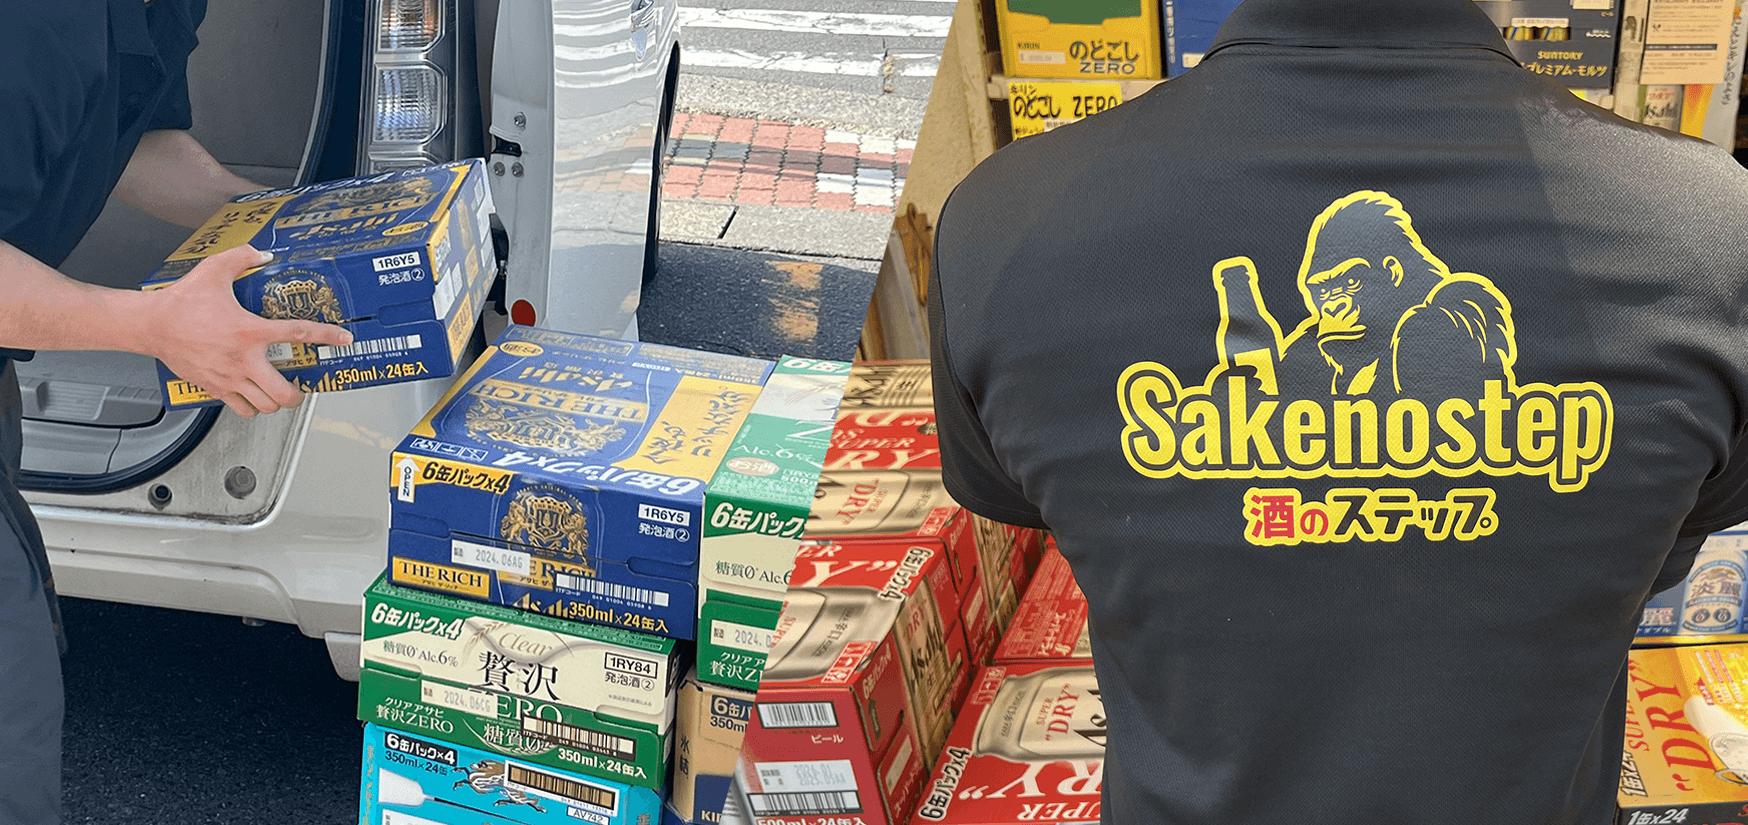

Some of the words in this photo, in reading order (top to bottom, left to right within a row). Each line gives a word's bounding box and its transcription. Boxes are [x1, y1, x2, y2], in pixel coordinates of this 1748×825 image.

[1069, 37, 1140, 61] のどごし
[1079, 61, 1136, 75] ZERO
[378, 254, 416, 269] 1R6Y5
[518, 366, 634, 393] Asahi
[474, 383, 564, 412] RICH
[569, 399, 641, 421] THE
[1131, 374, 1604, 480] Sakenostep
[402, 465, 412, 497] OPEN
[421, 461, 511, 493] 6缶パック×4
[644, 507, 685, 523] 1R6Y5
[1249, 493, 1495, 540] 酒のステップ
[638, 522, 690, 543] 発泡酒②
[475, 549, 524, 569] 2024.06AG
[399, 560, 436, 579] THE
[437, 567, 484, 588] RICH
[371, 602, 467, 640] 6缶パック×4
[570, 601, 669, 634] 350ml×24缶入
[499, 632, 553, 657] Clear
[477, 650, 561, 702] 贅沢
[610, 656, 651, 674] 1RY84
[604, 671, 656, 691] 発泡酒②
[376, 704, 454, 734] 贅沢ZERO
[384, 696, 445, 719] クリアアサヒ
[386, 732, 456, 765] 6缶パック×4
[811, 734, 844, 744] ビール
[384, 749, 449, 777] 350ml×24缶
[557, 747, 648, 780] 350ml×24缶入
[919, 745, 974, 822] 6缶パック×4
[572, 808, 604, 823] AV742
[1627, 808, 1690, 825] 1缶×24
